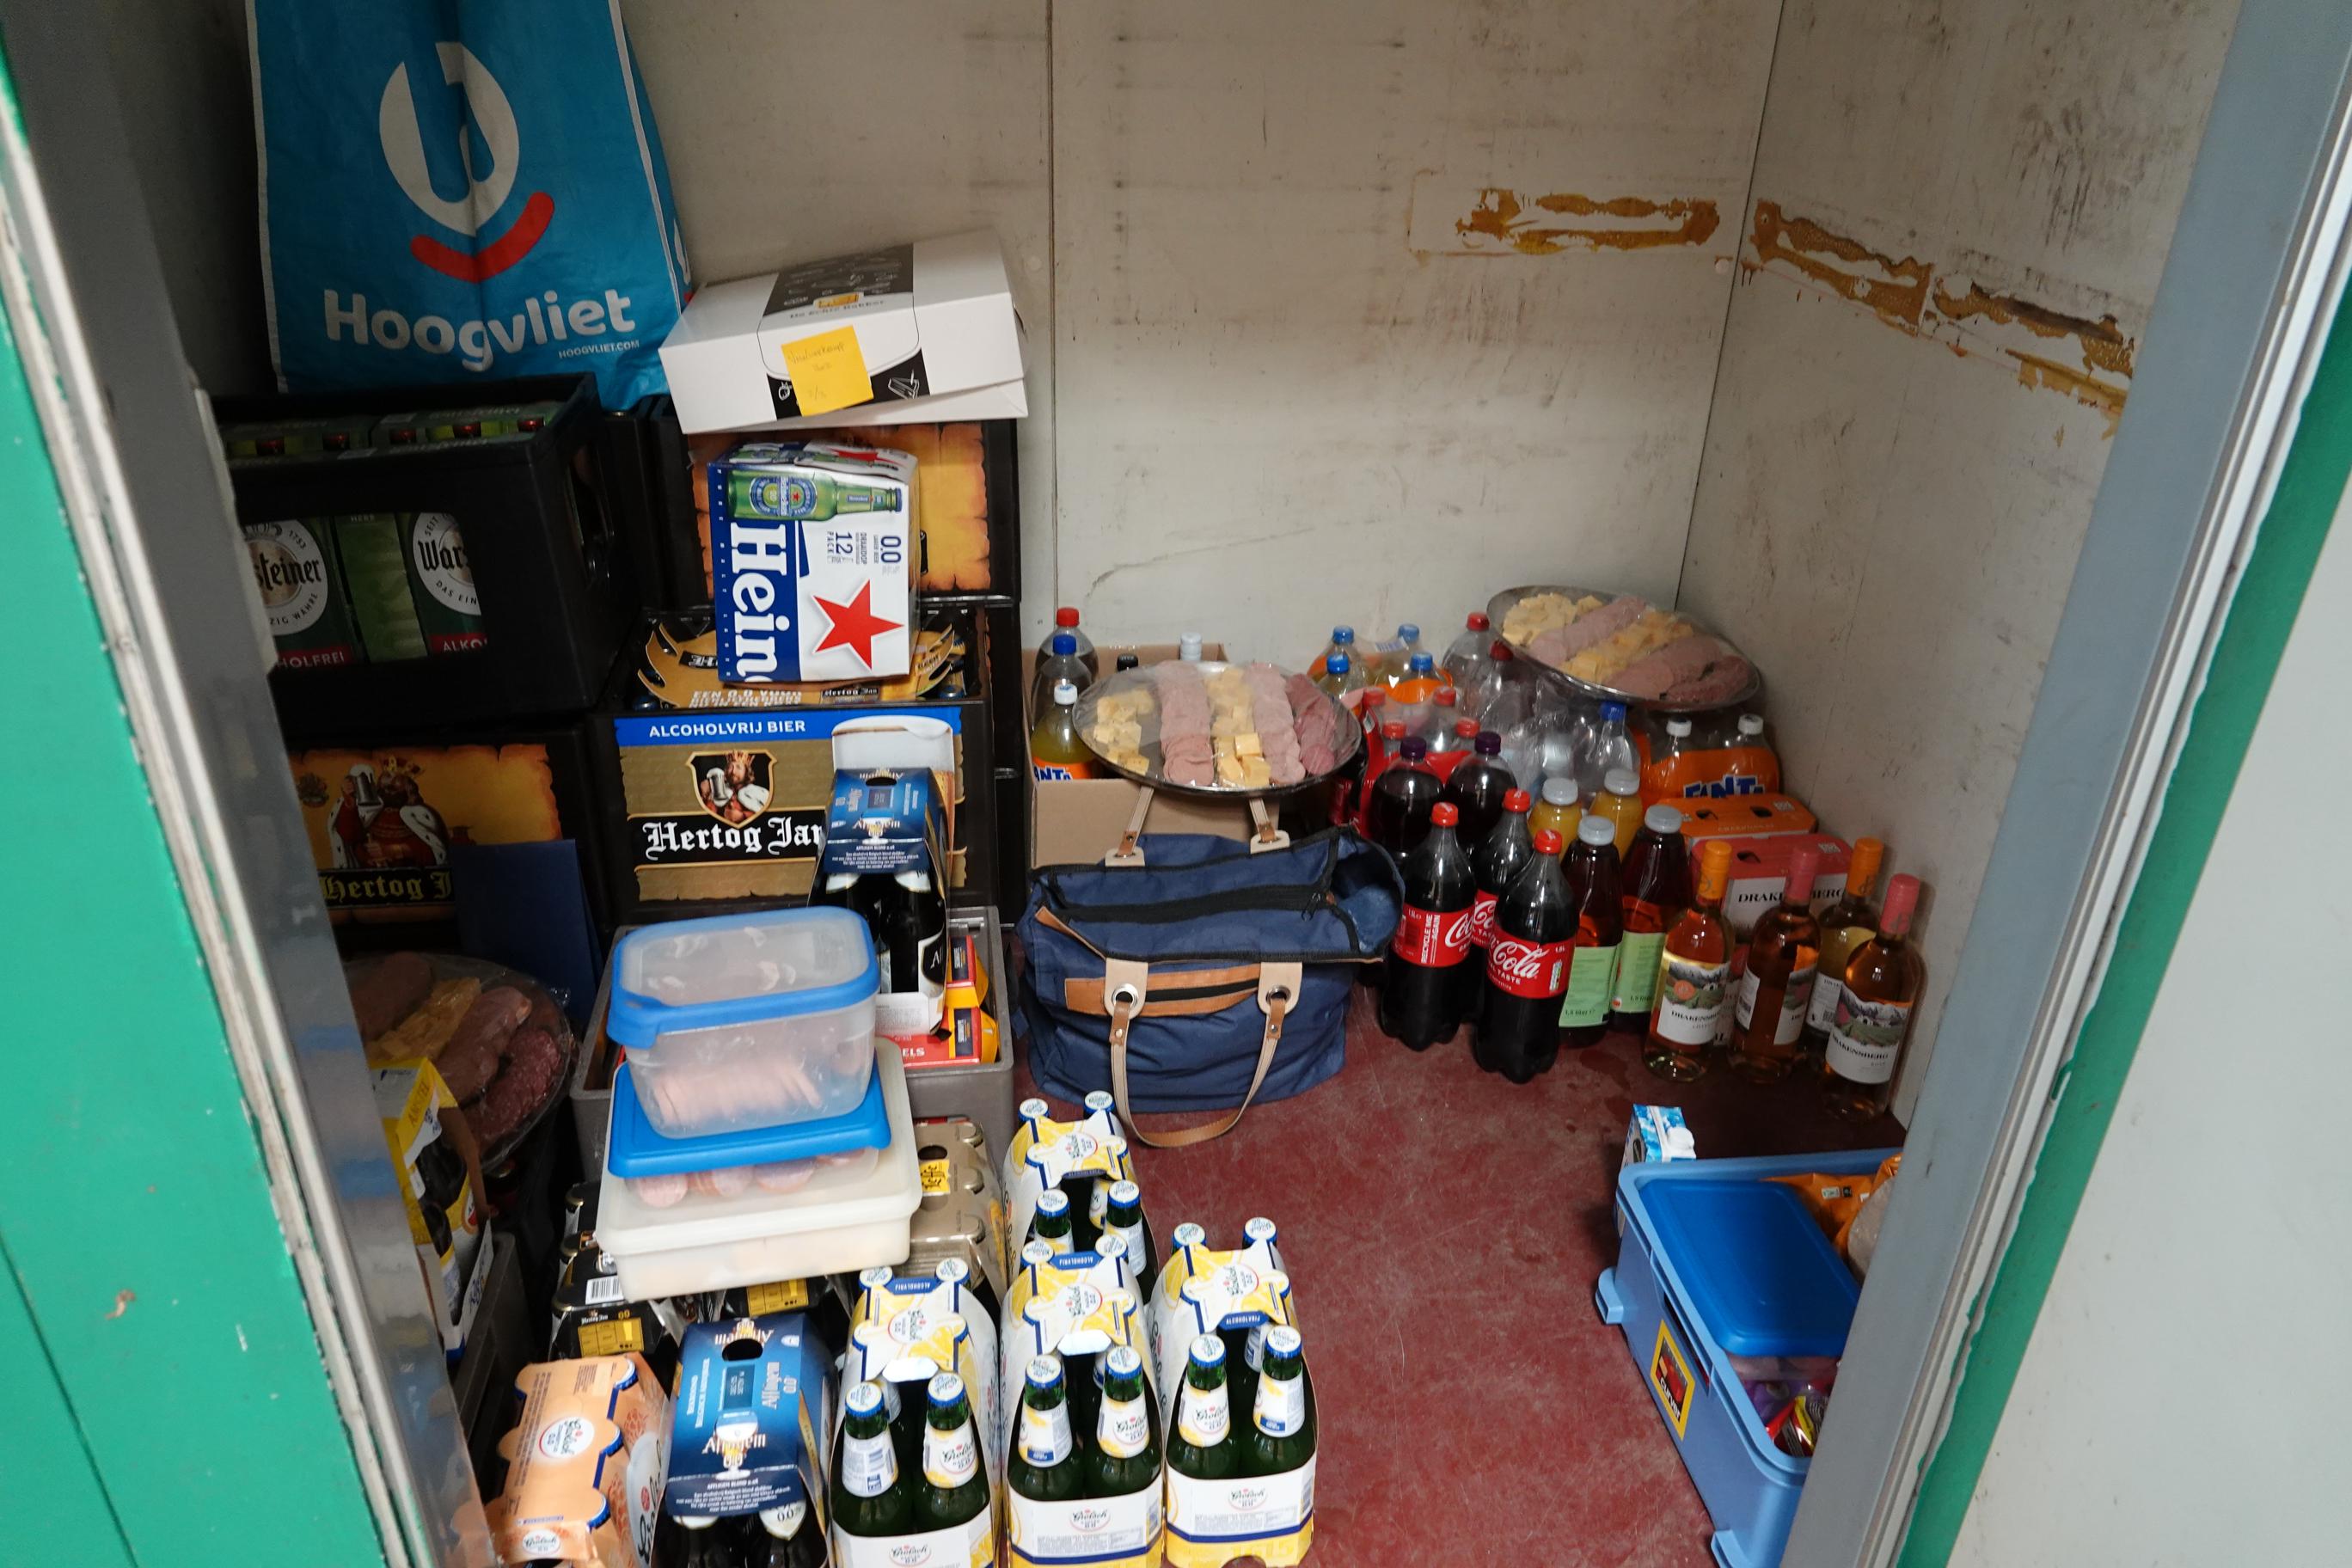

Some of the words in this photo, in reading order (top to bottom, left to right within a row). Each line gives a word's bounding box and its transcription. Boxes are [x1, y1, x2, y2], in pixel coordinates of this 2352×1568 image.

[323, 287, 636, 373] Hoogvliet
[558, 340, 640, 359] HOOGVLIET.COM
[287, 528, 307, 550] 1753
[826, 530, 835, 554] PACK
[835, 531, 854, 554] 12
[879, 535, 902, 565] 0.0
[435, 579, 455, 597] DAS
[457, 593, 477, 605] EIN
[730, 521, 791, 682] Hein
[269, 616, 290, 626] ZIG
[291, 591, 319, 621] WAHRE
[276, 651, 345, 670] HOLFREI
[648, 722, 763, 738] ALCOHOLVRIJ
[767, 720, 806, 734] BIER
[641, 820, 763, 862] Hertog
[1498, 970, 1522, 985] TASTE
[1660, 1376, 1681, 1420] curver
